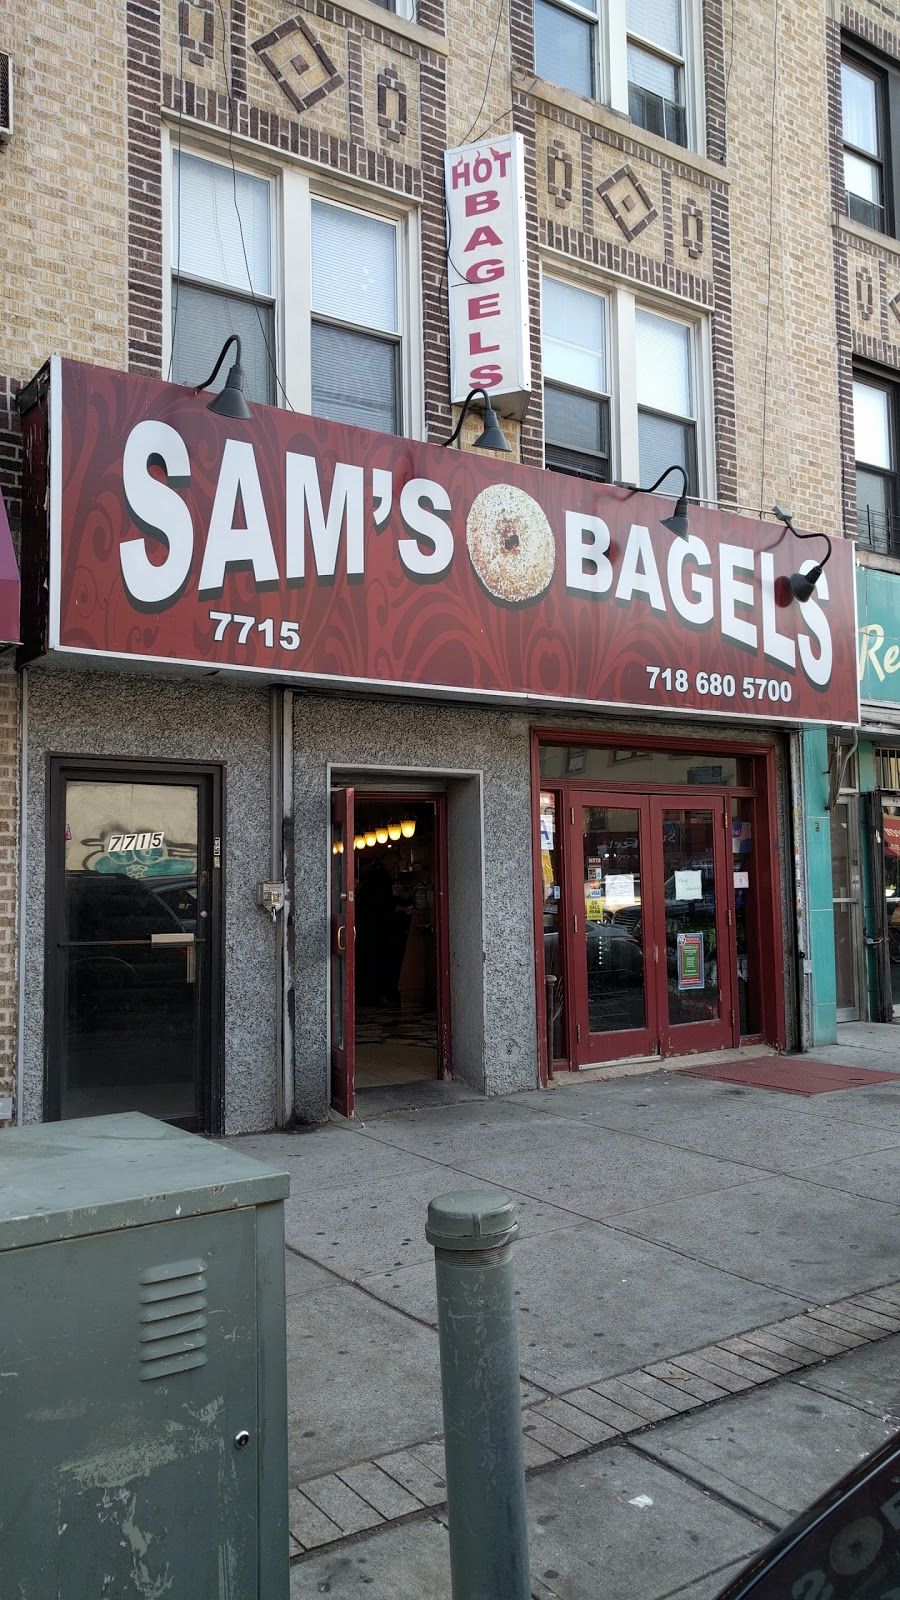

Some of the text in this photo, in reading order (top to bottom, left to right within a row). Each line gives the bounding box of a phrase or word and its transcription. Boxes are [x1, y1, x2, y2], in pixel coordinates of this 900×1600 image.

[452, 150, 511, 190] HOT
[463, 190, 505, 389] BAGELS
[118, 418, 835, 688] SAM'S BAGELS
[208, 610, 303, 652] 7715
[858, 623, 900, 683] Re
[645, 664, 793, 704] 718 680 5700
[109, 832, 162, 850] 7715
